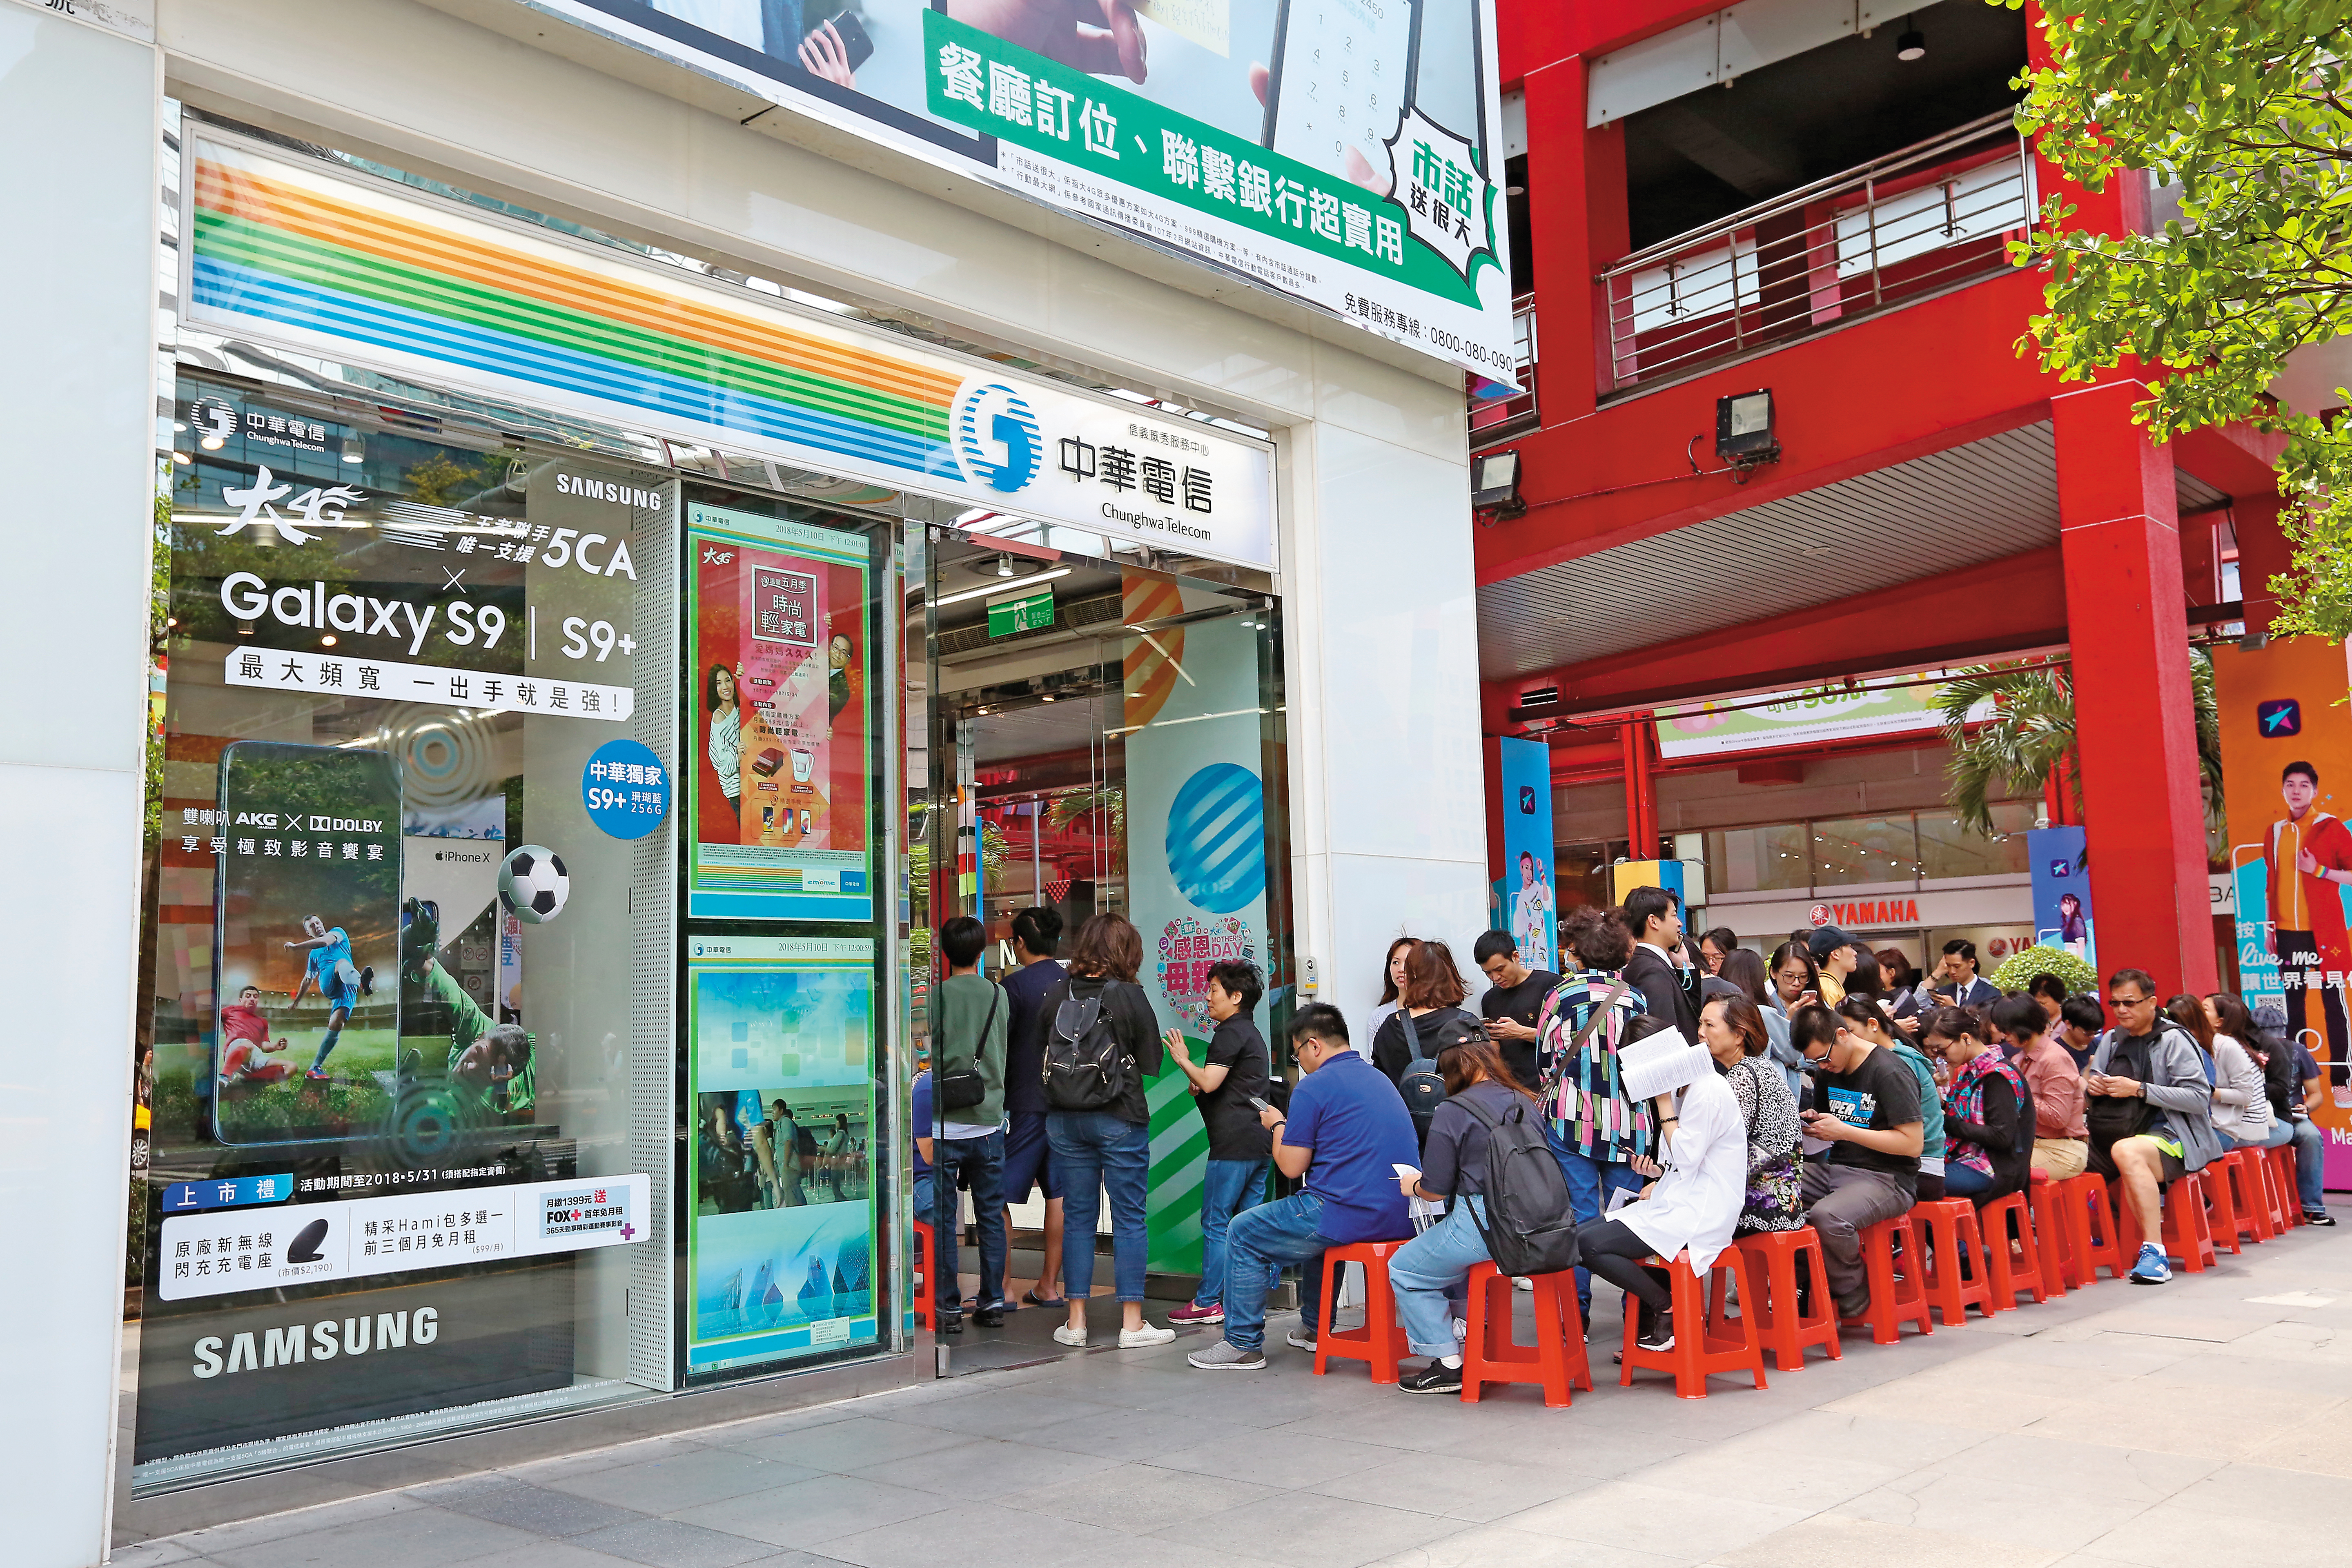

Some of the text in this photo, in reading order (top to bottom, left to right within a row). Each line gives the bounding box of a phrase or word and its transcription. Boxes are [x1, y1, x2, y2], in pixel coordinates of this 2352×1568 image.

[1319, 14, 1323, 24] 1
[1314, 49, 1320, 59] 4
[1346, 36, 1352, 49] 2
[1343, 70, 1349, 82] 5
[1374, 59, 1380, 71] 3
[1311, 81, 1317, 93] 7
[1339, 105, 1345, 117] 8
[1370, 94, 1377, 105] 6
[1368, 128, 1374, 140] 9
[939, 41, 1403, 265] 餐廳訂位、聯繫銀行超實用
[1335, 141, 1342, 153] 0
[1412, 138, 1473, 217] 市話
[1411, 182, 1472, 247] 送很大
[246, 412, 325, 442] 中華電信
[247, 431, 325, 453] Chunghwa Telecom
[1129, 423, 1209, 456] 信義威秀服務中心
[1058, 436, 1212, 514] 中華電信
[557, 473, 661, 511] SAMSUNG
[475, 515, 551, 542] 王者聯手
[1102, 503, 1211, 541] Chunghwa Telecom
[776, 525, 866, 549] 2018年5月10日 下午 12:01:01
[455, 535, 537, 564] 唯一支援
[541, 527, 637, 581] 5CA
[220, 571, 637, 662] Galaxy S9 S9+
[773, 594, 802, 619] 時尚
[761, 609, 807, 638] 輕家電
[1033, 617, 1050, 625] EXIT
[239, 654, 380, 690] 最大頻寬
[589, 760, 662, 786] 中華獨家
[588, 788, 662, 810] S9+ 珊瑚藍
[631, 803, 662, 815] 256G
[183, 807, 230, 826] 雙喇叭
[235, 812, 278, 825] AKG
[182, 835, 383, 861] 享受極致影音饗宴
[445, 851, 490, 862] iPhone X
[1833, 899, 1919, 924] YAMAHA
[1212, 934, 1243, 943] MOTHER'S
[2236, 920, 2275, 939] 按下
[778, 942, 872, 952] 2018年5月10日 下午 12:00:59
[1174, 935, 1211, 960] 感恩
[1212, 941, 1243, 958] DAY
[2009, 936, 2036, 954] YA
[177, 1178, 275, 1207] 上市禮
[593, 1189, 607, 1205] 送
[364, 1210, 503, 1237] 精采Hami包多選一
[584, 1206, 624, 1219] 首年免月租
[174, 1232, 273, 1258] 原廠新無線
[364, 1229, 477, 1256] 前三個月免月租
[472, 1243, 503, 1255] ($99/月)
[174, 1252, 272, 1279] 閃充充電座
[278, 1263, 333, 1278] (市價$2,190)
[193, 1306, 439, 1379] SAMSUNG
